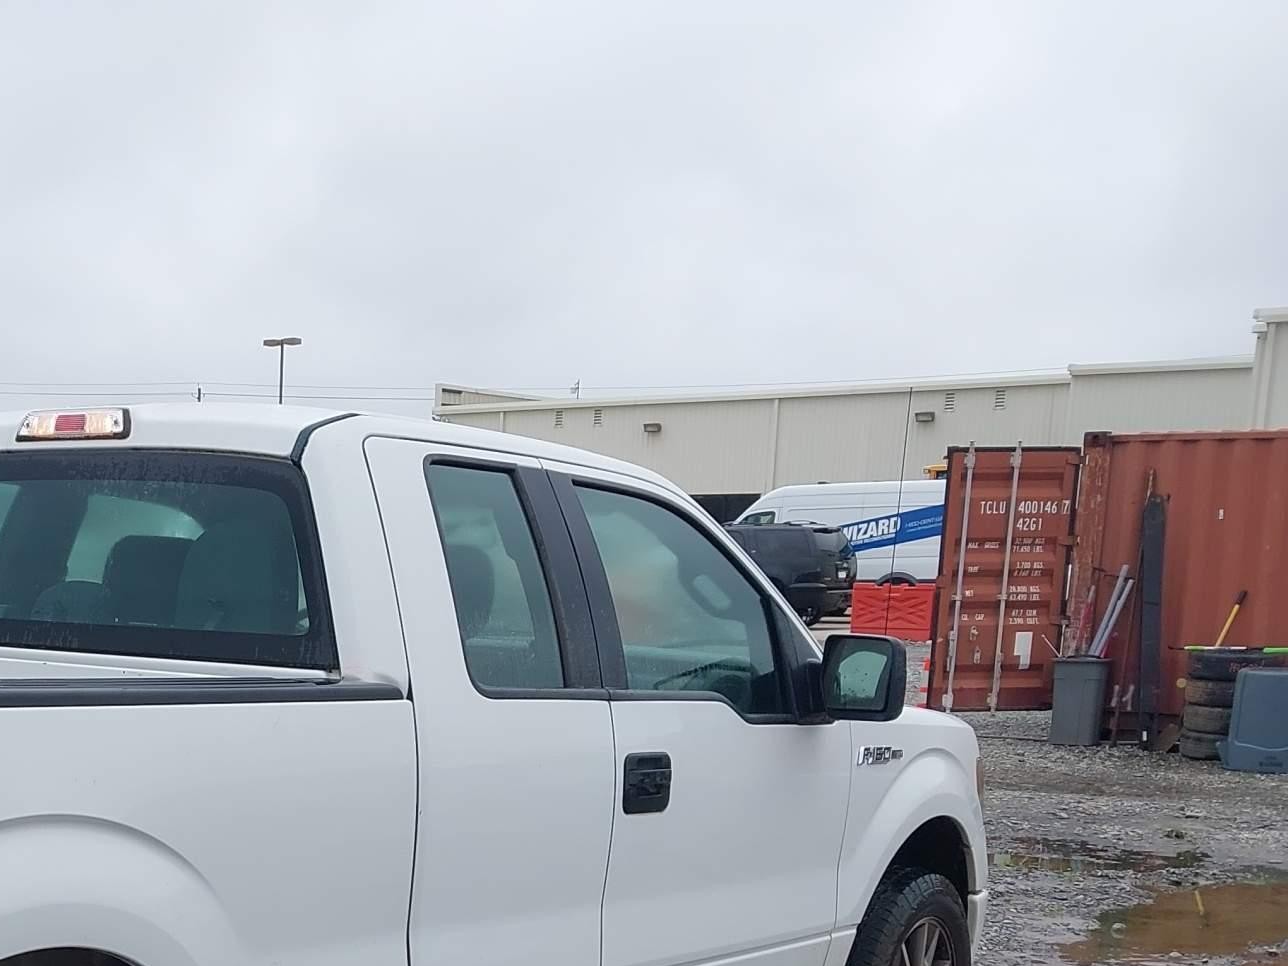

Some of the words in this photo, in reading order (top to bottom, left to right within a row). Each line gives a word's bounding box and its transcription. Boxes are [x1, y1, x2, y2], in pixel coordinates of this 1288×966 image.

[980, 501, 1006, 514] TCLU
[1018, 500, 1058, 514] 400146
[1062, 500, 1070, 514] 7
[1016, 518, 1043, 531] 42G1
